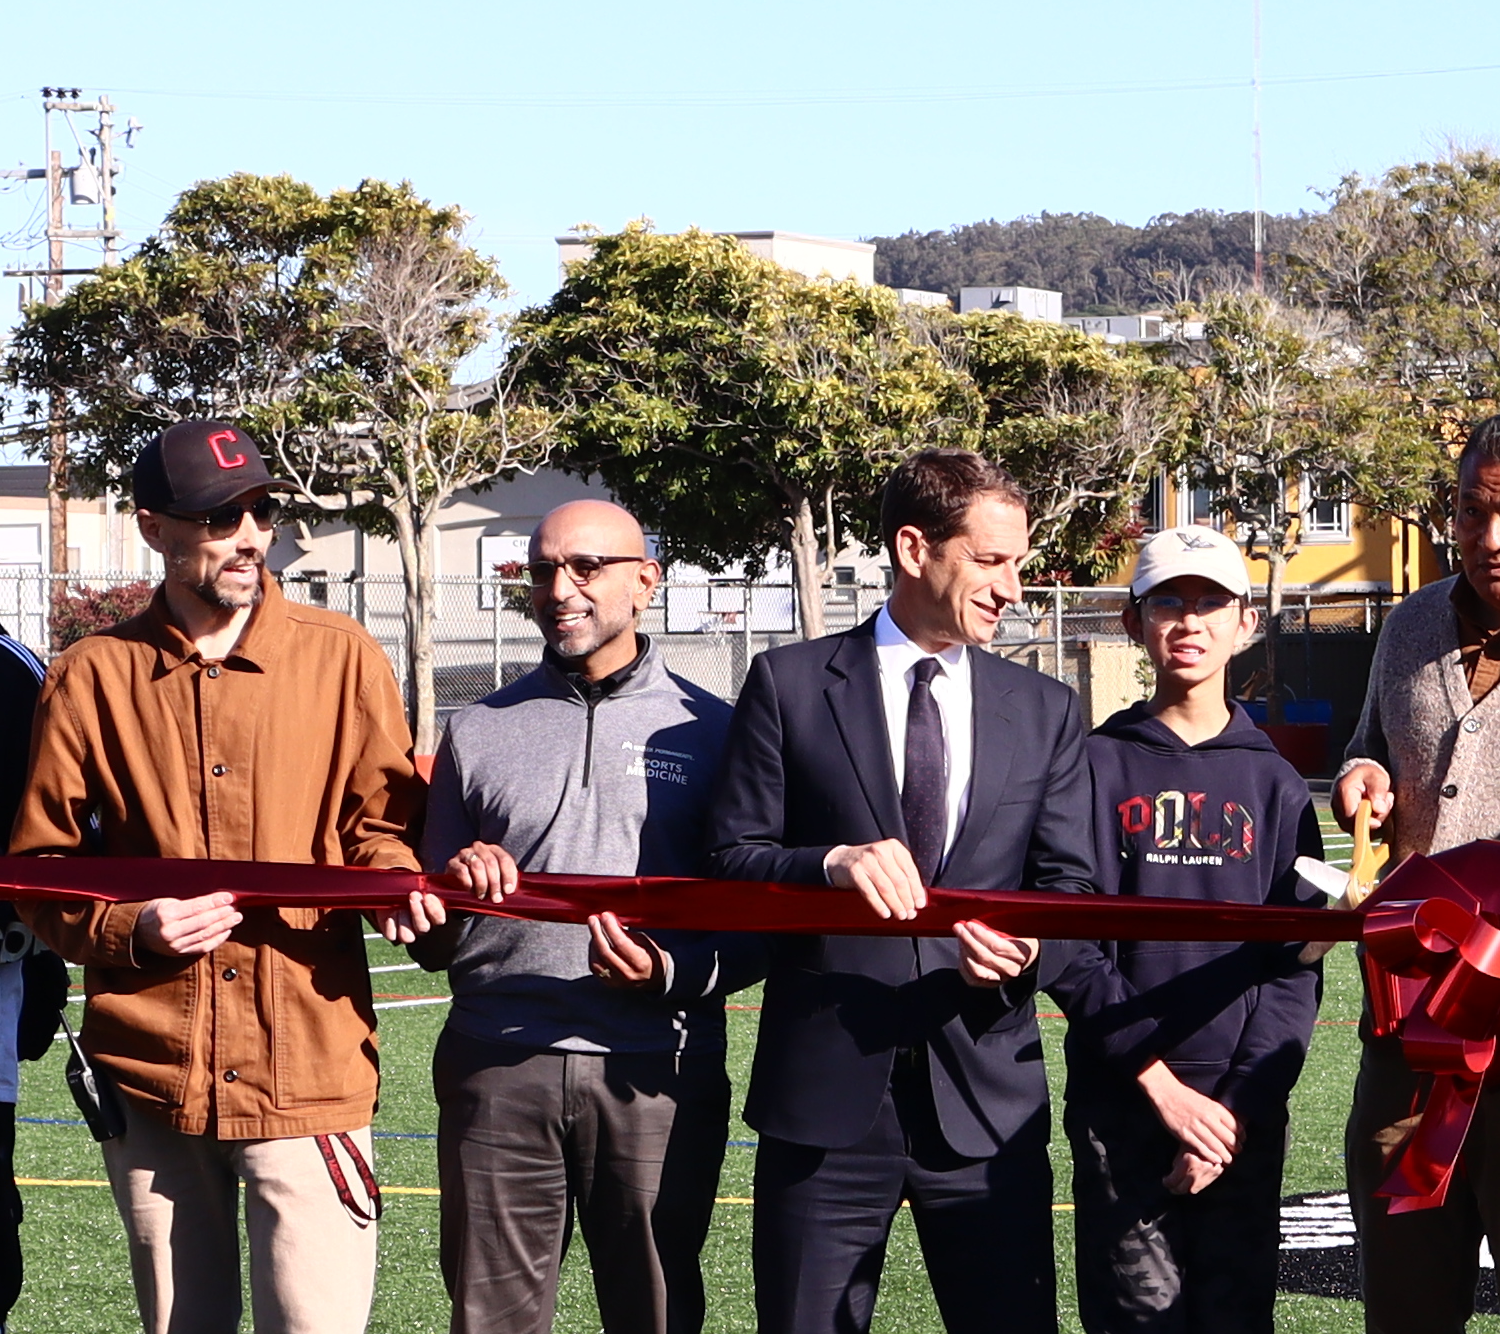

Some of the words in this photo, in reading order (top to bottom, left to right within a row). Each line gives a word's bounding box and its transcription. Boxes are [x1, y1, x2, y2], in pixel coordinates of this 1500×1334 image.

[208, 430, 247, 469] C
[626, 764, 688, 785] MEDICINE
[633, 756, 682, 773] SPORTS
[1117, 790, 1254, 863] POLO
[1146, 852, 1178, 865] RALPH
[1182, 854, 1223, 866] LAUREN
